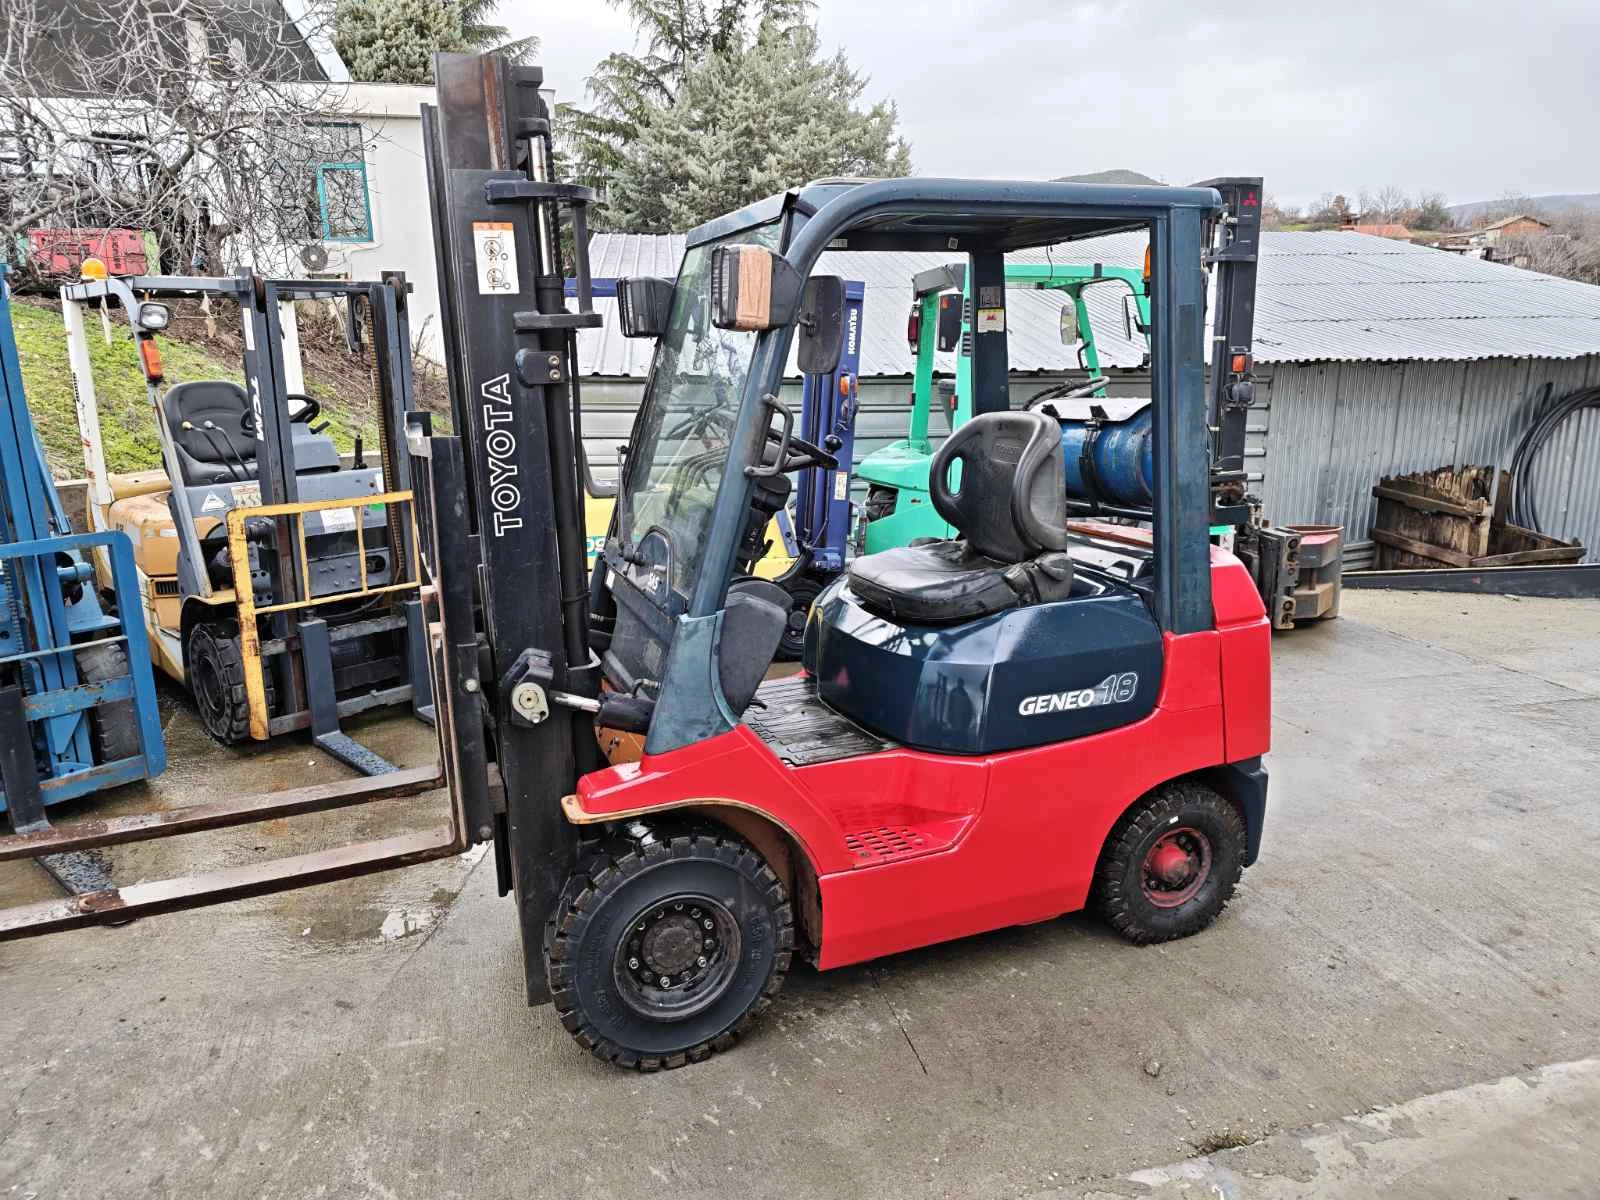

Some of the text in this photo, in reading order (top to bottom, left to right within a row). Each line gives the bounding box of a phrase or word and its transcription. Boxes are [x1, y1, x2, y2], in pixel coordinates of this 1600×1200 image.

[847, 308, 858, 355] KOMATSU
[250, 375, 265, 442] TCM
[481, 372, 523, 537] TOYOTA
[1018, 672, 1138, 716] GENEO 18
